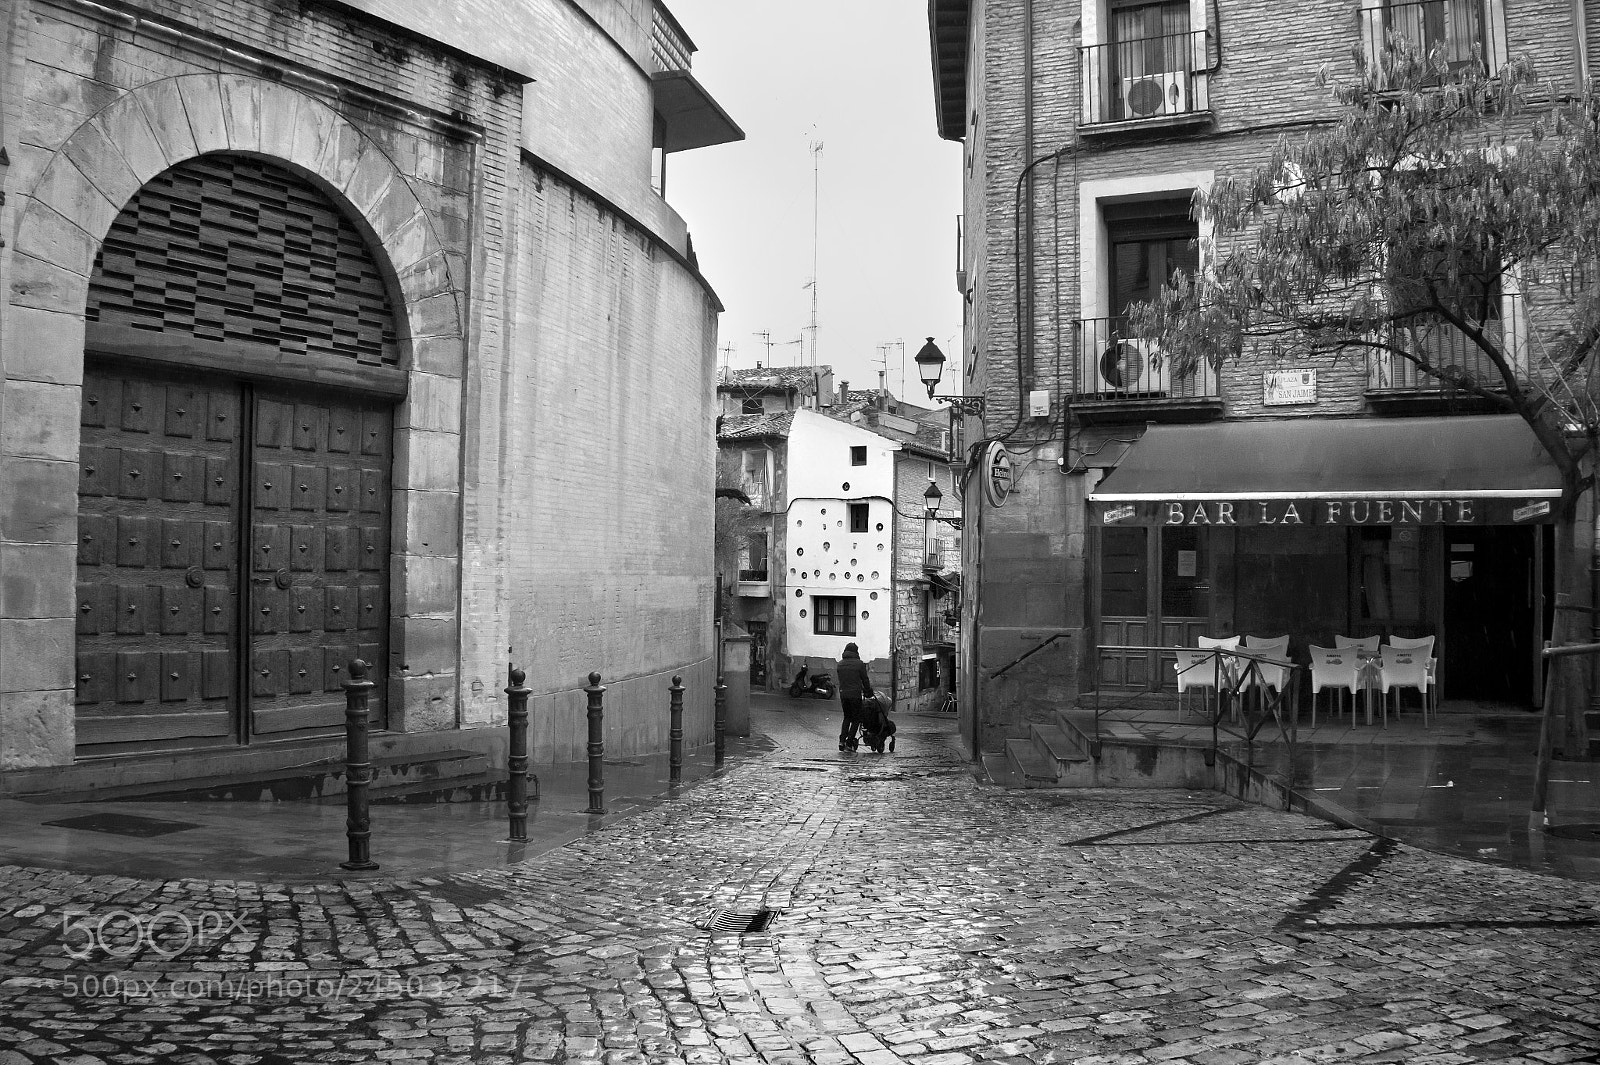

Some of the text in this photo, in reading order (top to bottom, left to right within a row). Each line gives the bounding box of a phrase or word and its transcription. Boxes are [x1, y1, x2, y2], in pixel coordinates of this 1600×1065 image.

[1278, 388, 1313, 399] SAN JAIME
[1165, 500, 1475, 525] BAR LA FUENTE
